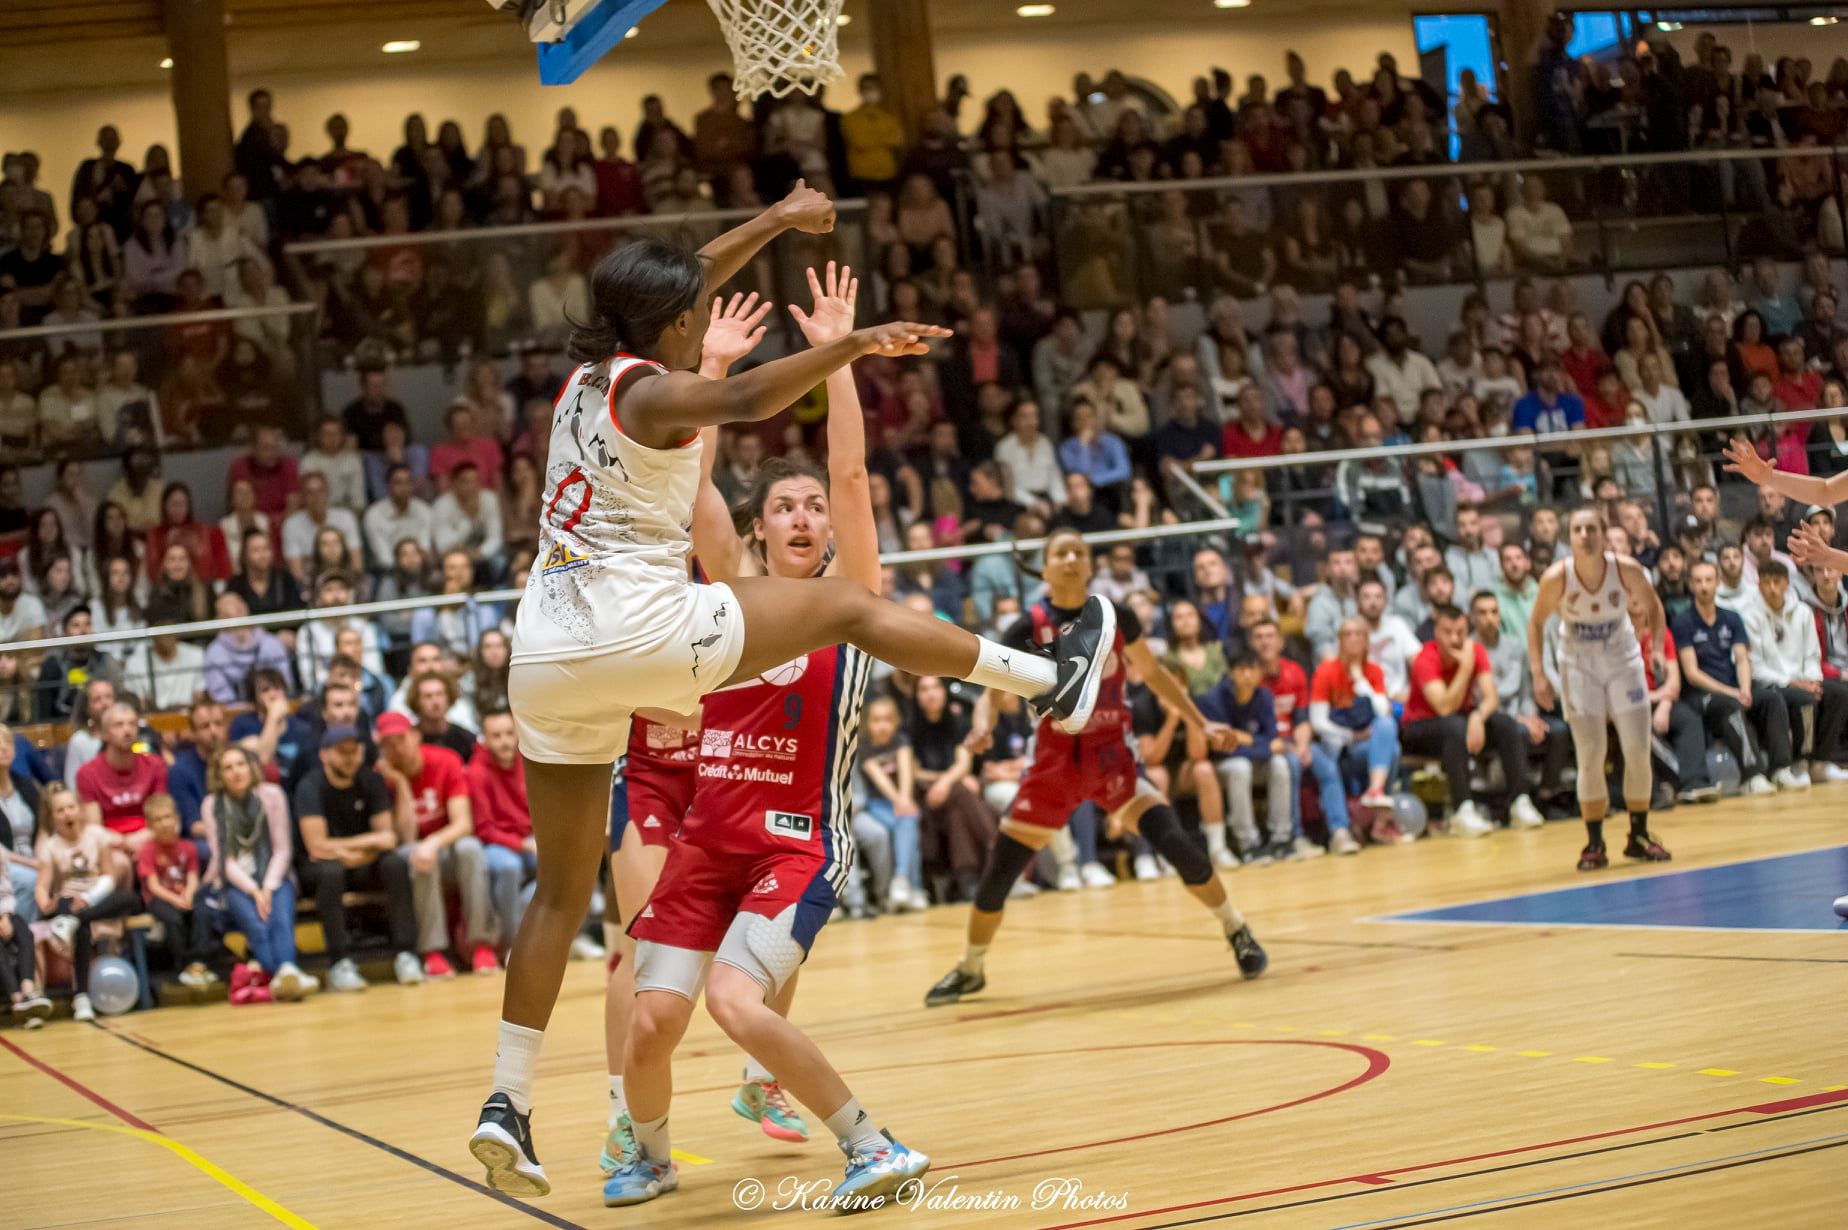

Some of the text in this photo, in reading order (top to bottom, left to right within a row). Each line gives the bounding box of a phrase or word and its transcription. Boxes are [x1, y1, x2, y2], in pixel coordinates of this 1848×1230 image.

[783, 692, 803, 730] 9
[733, 733, 798, 753] ALCYS
[698, 762, 794, 785] Crédit Mutuel
